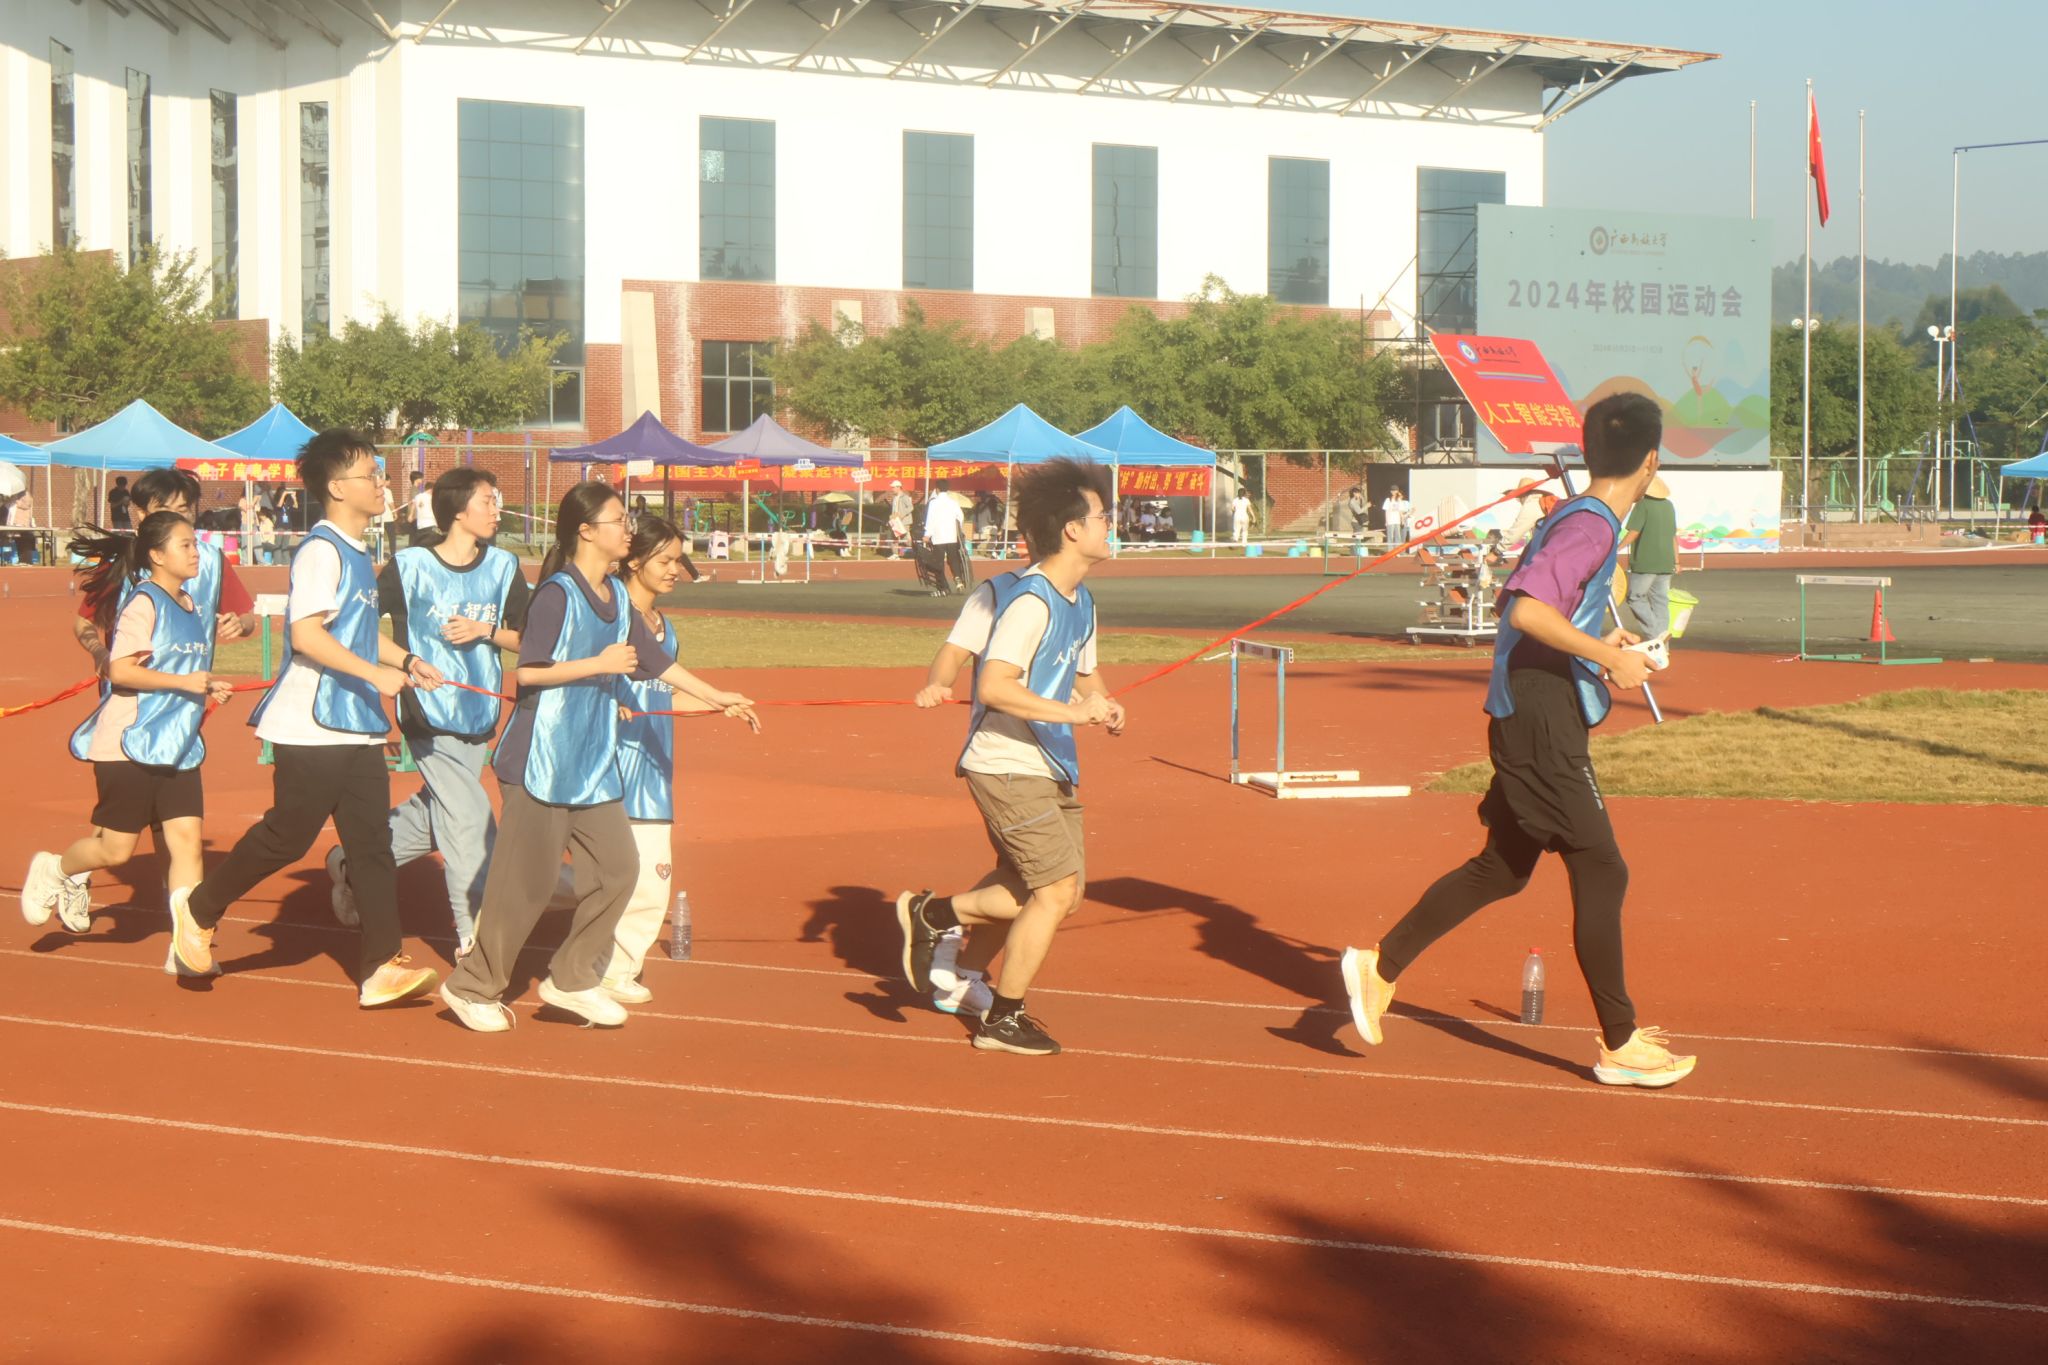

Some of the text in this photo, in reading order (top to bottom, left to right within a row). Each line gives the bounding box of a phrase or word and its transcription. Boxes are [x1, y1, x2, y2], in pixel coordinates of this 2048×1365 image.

[1507, 279, 1743, 317] 2024年校园运动会
[1484, 401, 1581, 428] 人工智能学院
[198, 462, 297, 479] 电子信息学院
